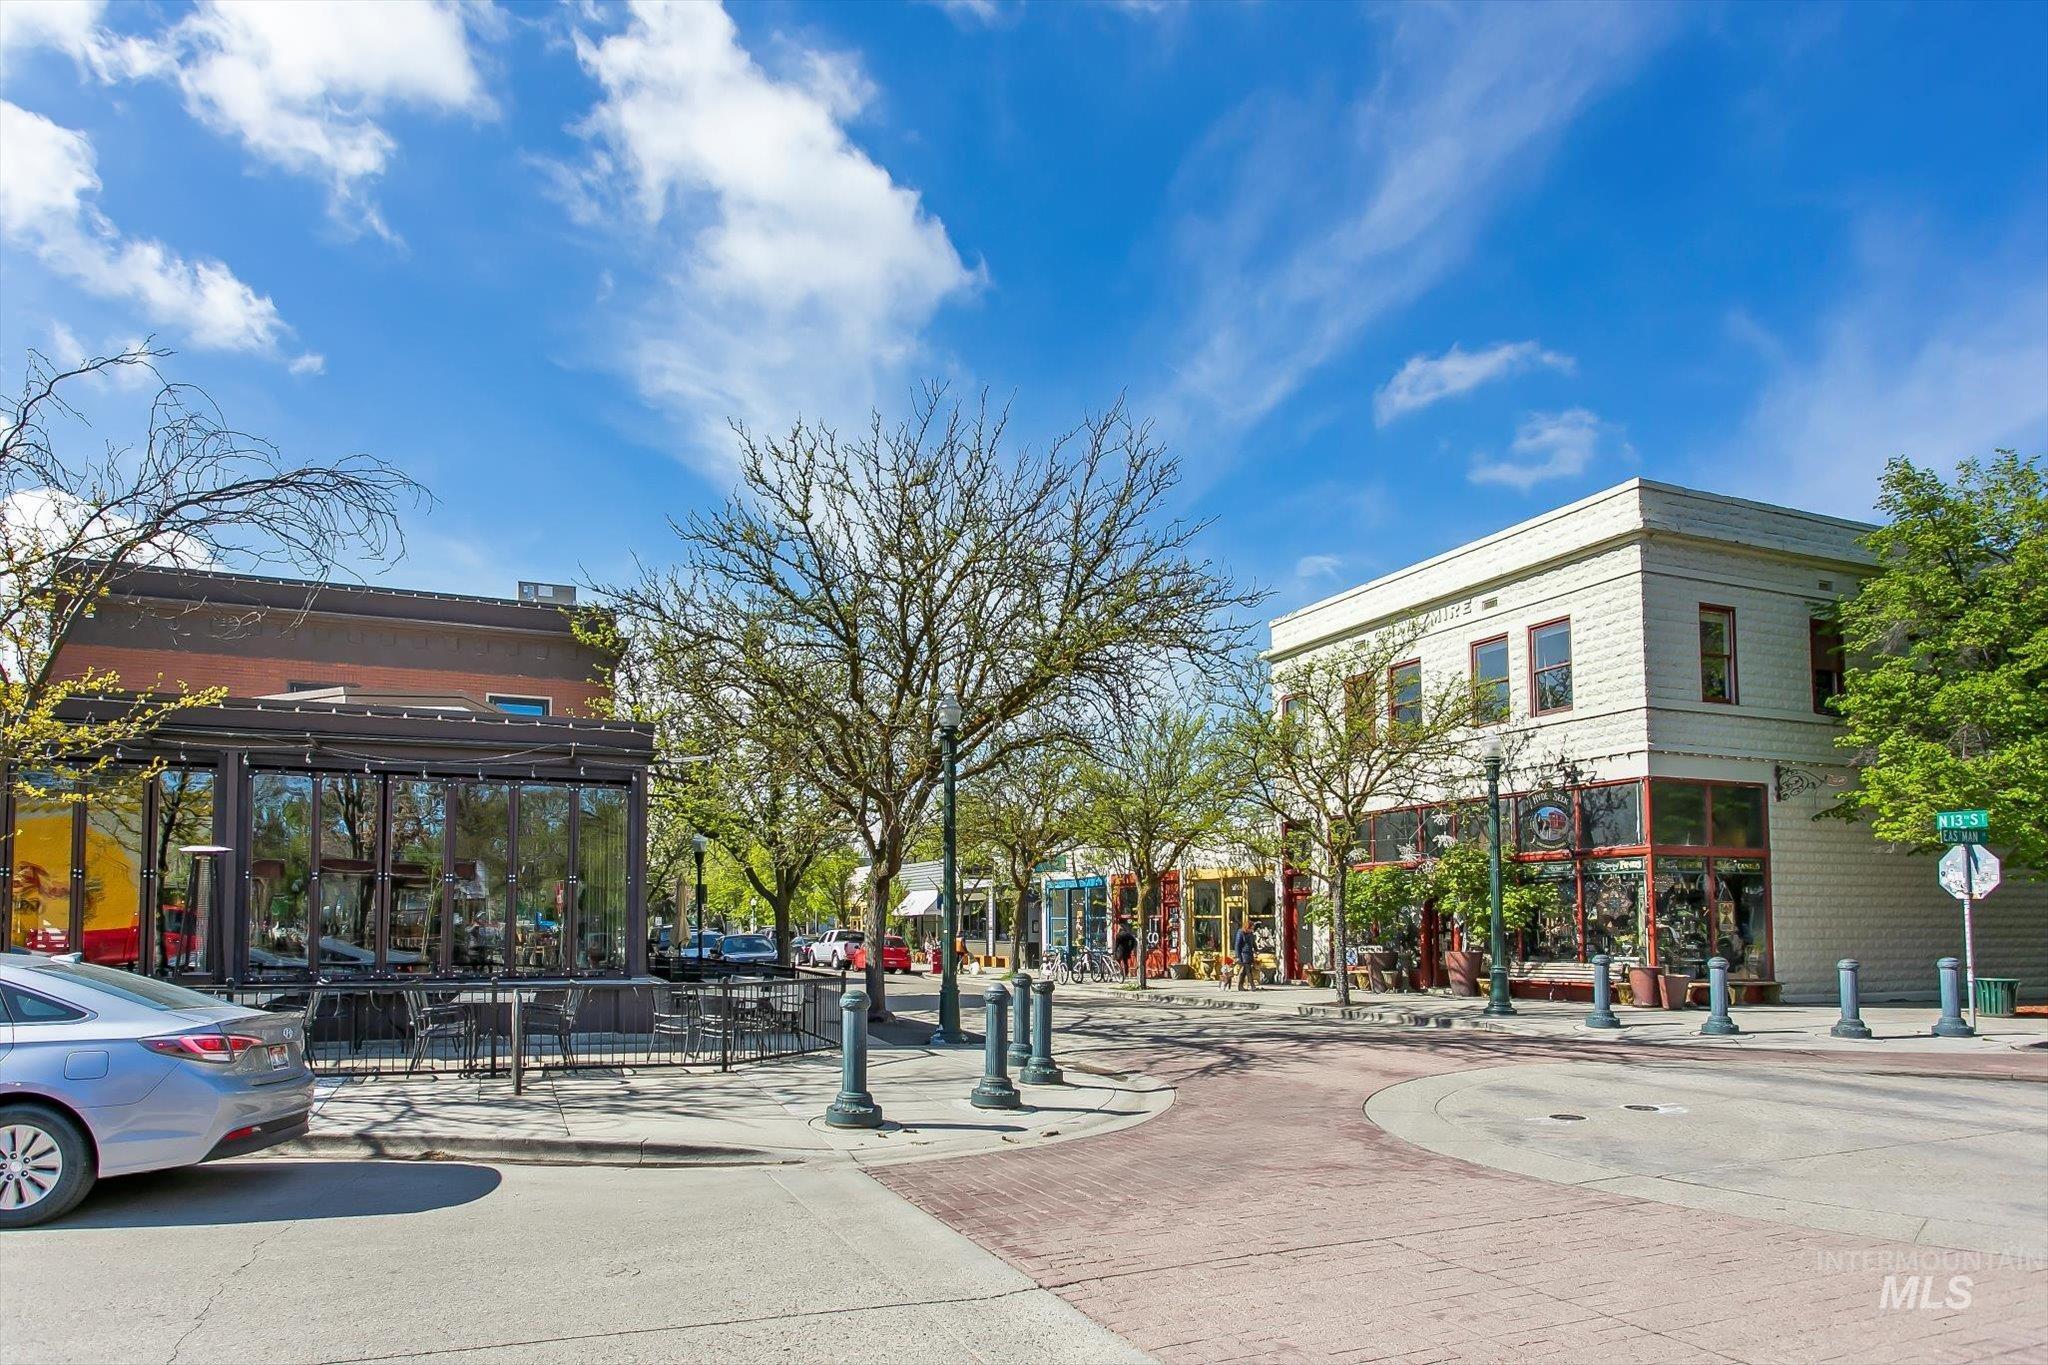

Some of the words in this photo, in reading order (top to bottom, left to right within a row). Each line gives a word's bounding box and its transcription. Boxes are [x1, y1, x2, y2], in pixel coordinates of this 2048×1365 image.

[1532, 792, 1549, 805] HYDE
[1939, 815, 1948, 827] N
[1970, 813, 1986, 826] ST
